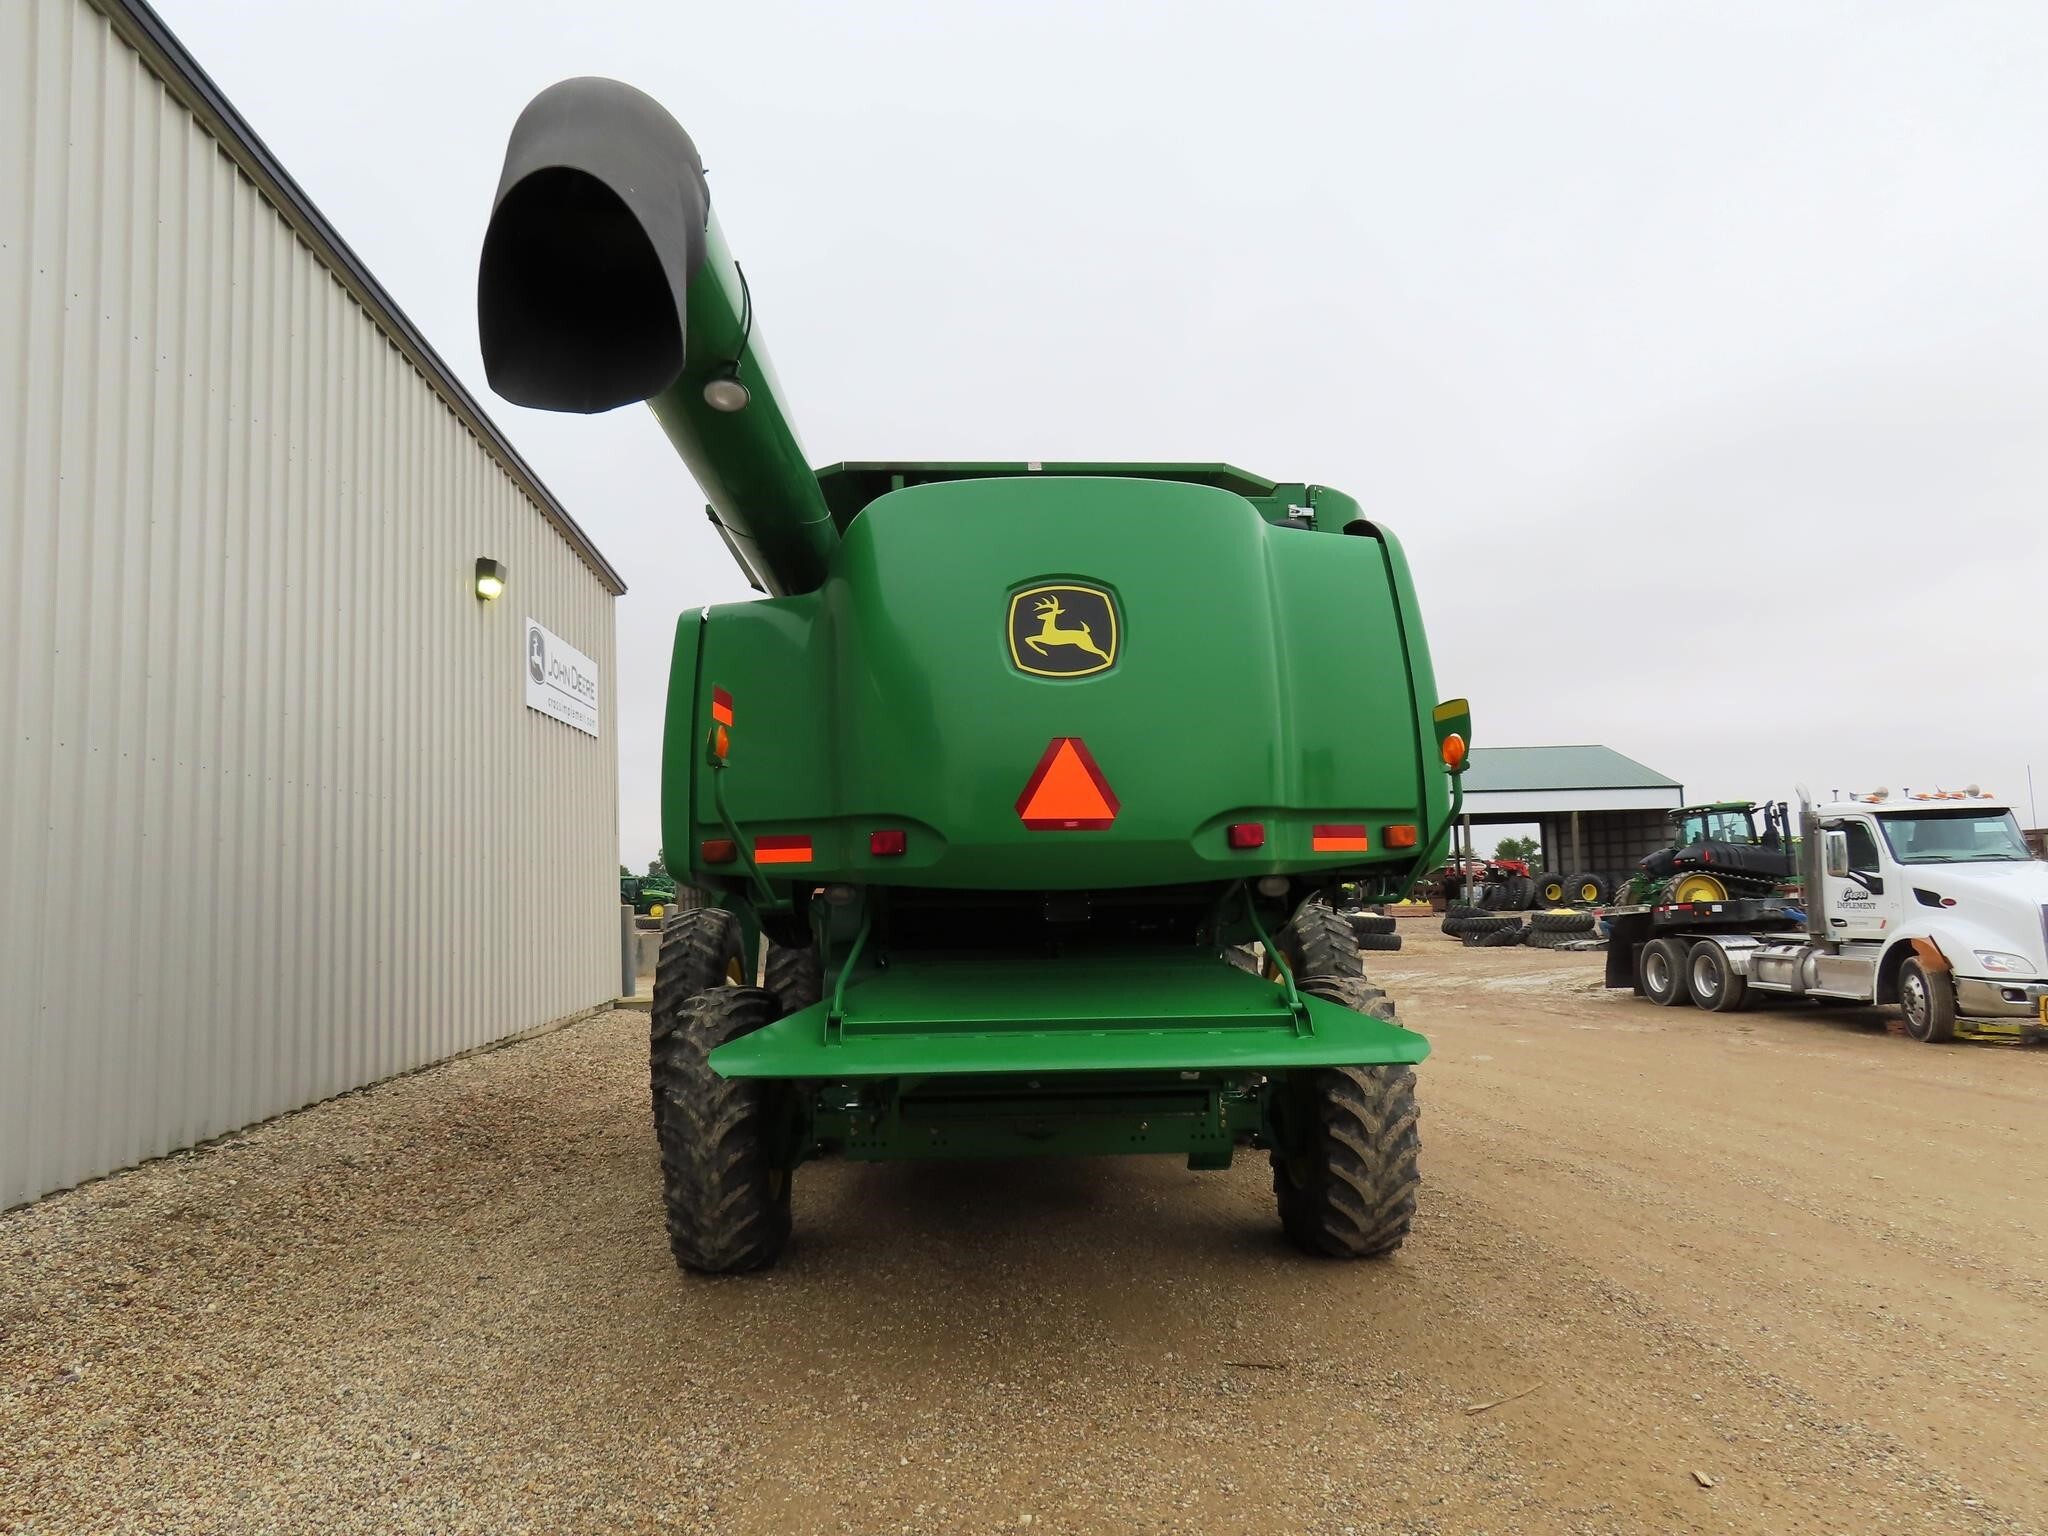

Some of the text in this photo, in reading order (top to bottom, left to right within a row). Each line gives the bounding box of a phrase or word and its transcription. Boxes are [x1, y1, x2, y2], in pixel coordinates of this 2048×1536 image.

[547, 652, 595, 701] JOHN DEERE
[1837, 901, 1876, 909] IMPLEMENT
